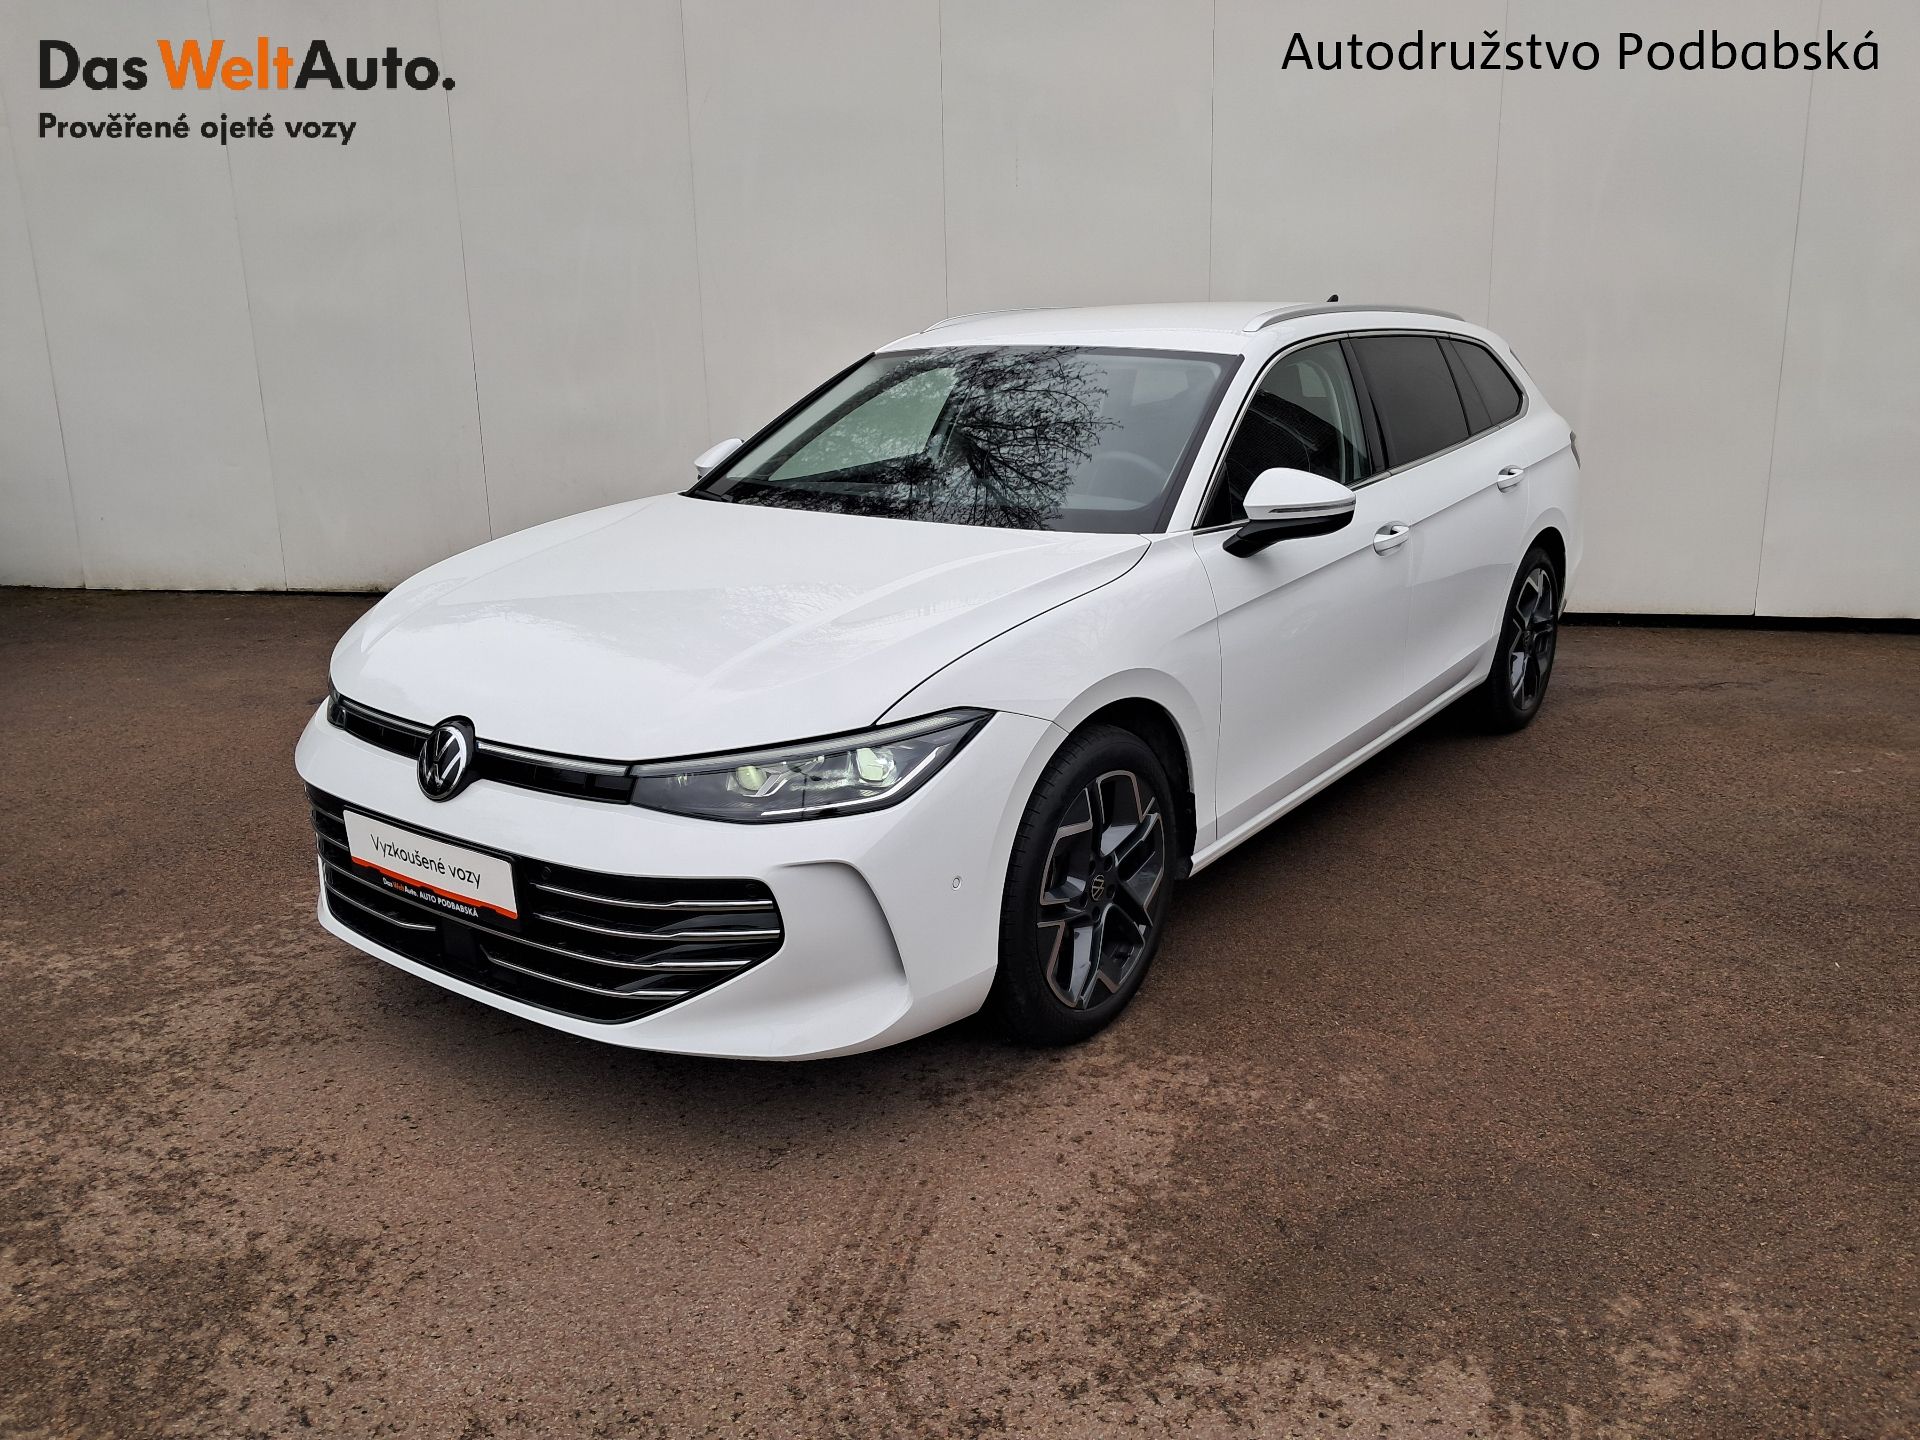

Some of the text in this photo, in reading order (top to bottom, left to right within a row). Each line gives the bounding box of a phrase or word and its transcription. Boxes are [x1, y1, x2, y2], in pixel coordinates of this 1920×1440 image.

[370, 834, 482, 890] Vyzkoušené vozy
[420, 891, 479, 918] AUTO PODBABSKÁ
